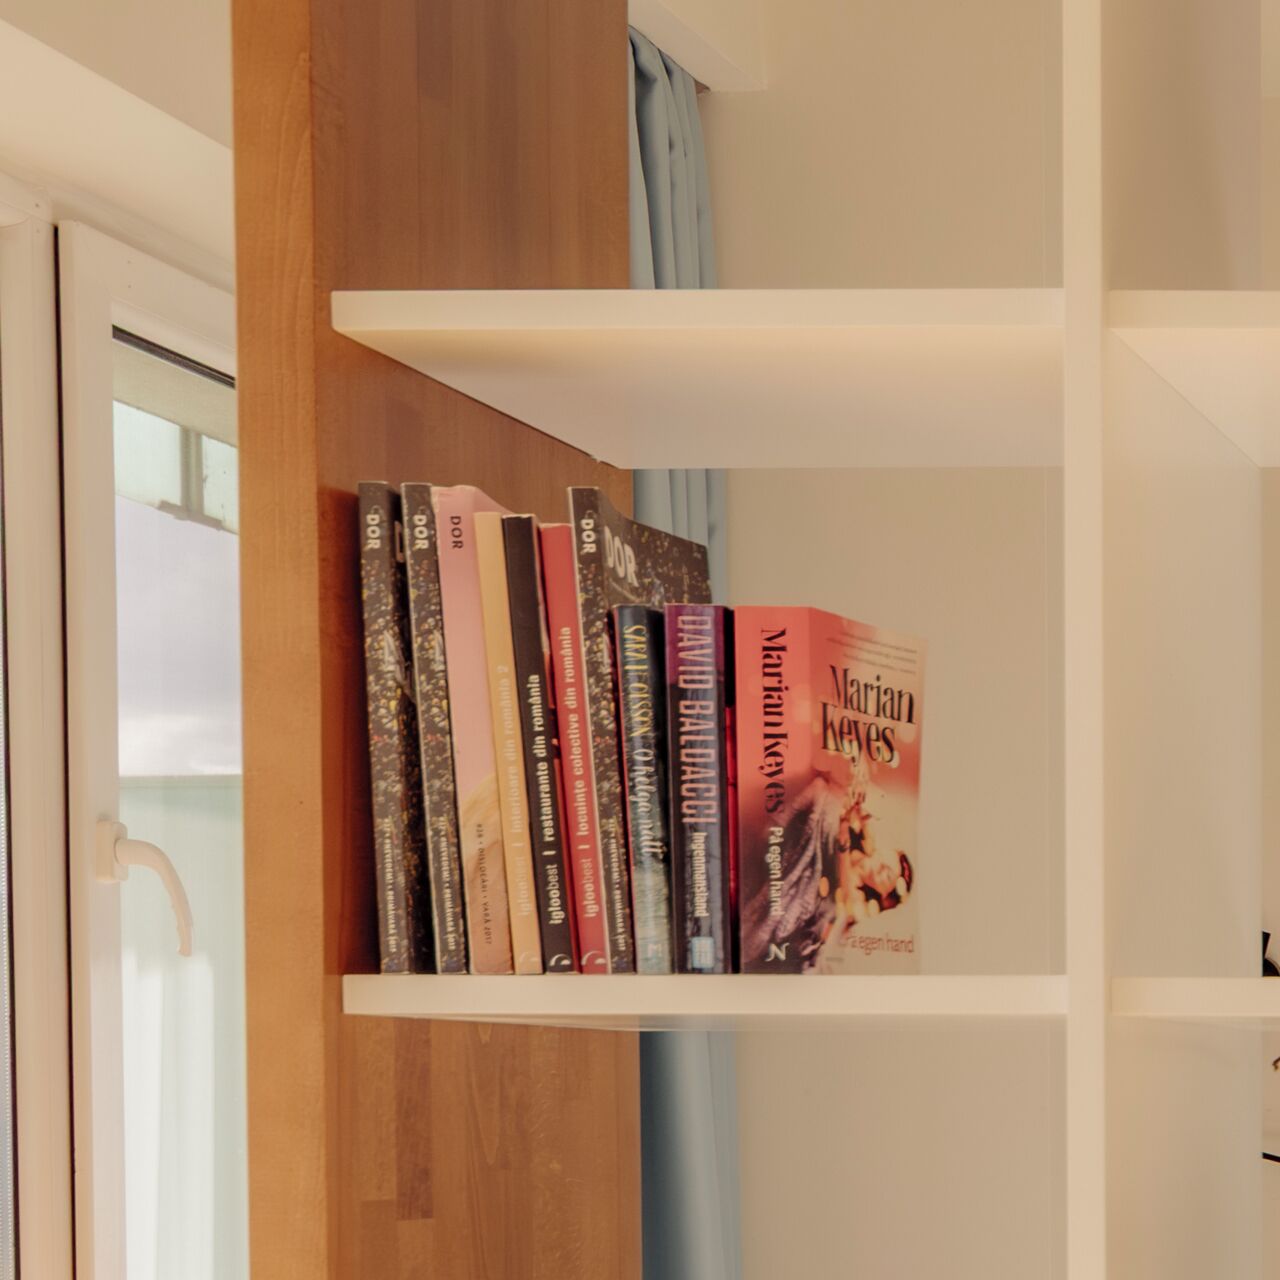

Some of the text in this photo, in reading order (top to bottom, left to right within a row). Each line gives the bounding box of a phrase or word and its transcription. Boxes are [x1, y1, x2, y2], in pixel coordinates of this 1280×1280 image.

[363, 514, 381, 551] DOR
[413, 514, 429, 551] DOR
[450, 515, 464, 550] DOR
[580, 518, 597, 555] DOR
[604, 525, 640, 588] DOR
[558, 627, 575, 683] românia
[623, 624, 647, 661] SARA
[496, 665, 509, 673] 2
[564, 687, 577, 709] din
[629, 682, 652, 737] OLSSON
[677, 615, 718, 823] DAVID BALDACCI
[829, 664, 916, 725] Marian
[567, 713, 584, 775] colective
[758, 627, 789, 813] Marian Keyes
[821, 701, 896, 767] Keyes
[504, 739, 516, 761] din
[633, 748, 654, 761] O
[526, 674, 565, 925] igloobest restaurante din românia
[629, 766, 657, 812] helga
[639, 819, 667, 854] natt
[579, 858, 599, 918] igloobest
[691, 831, 710, 918] Ingenmansland
[765, 826, 785, 916] På egen hand
[858, 936, 882, 956] egen
[886, 932, 914, 953] hand
